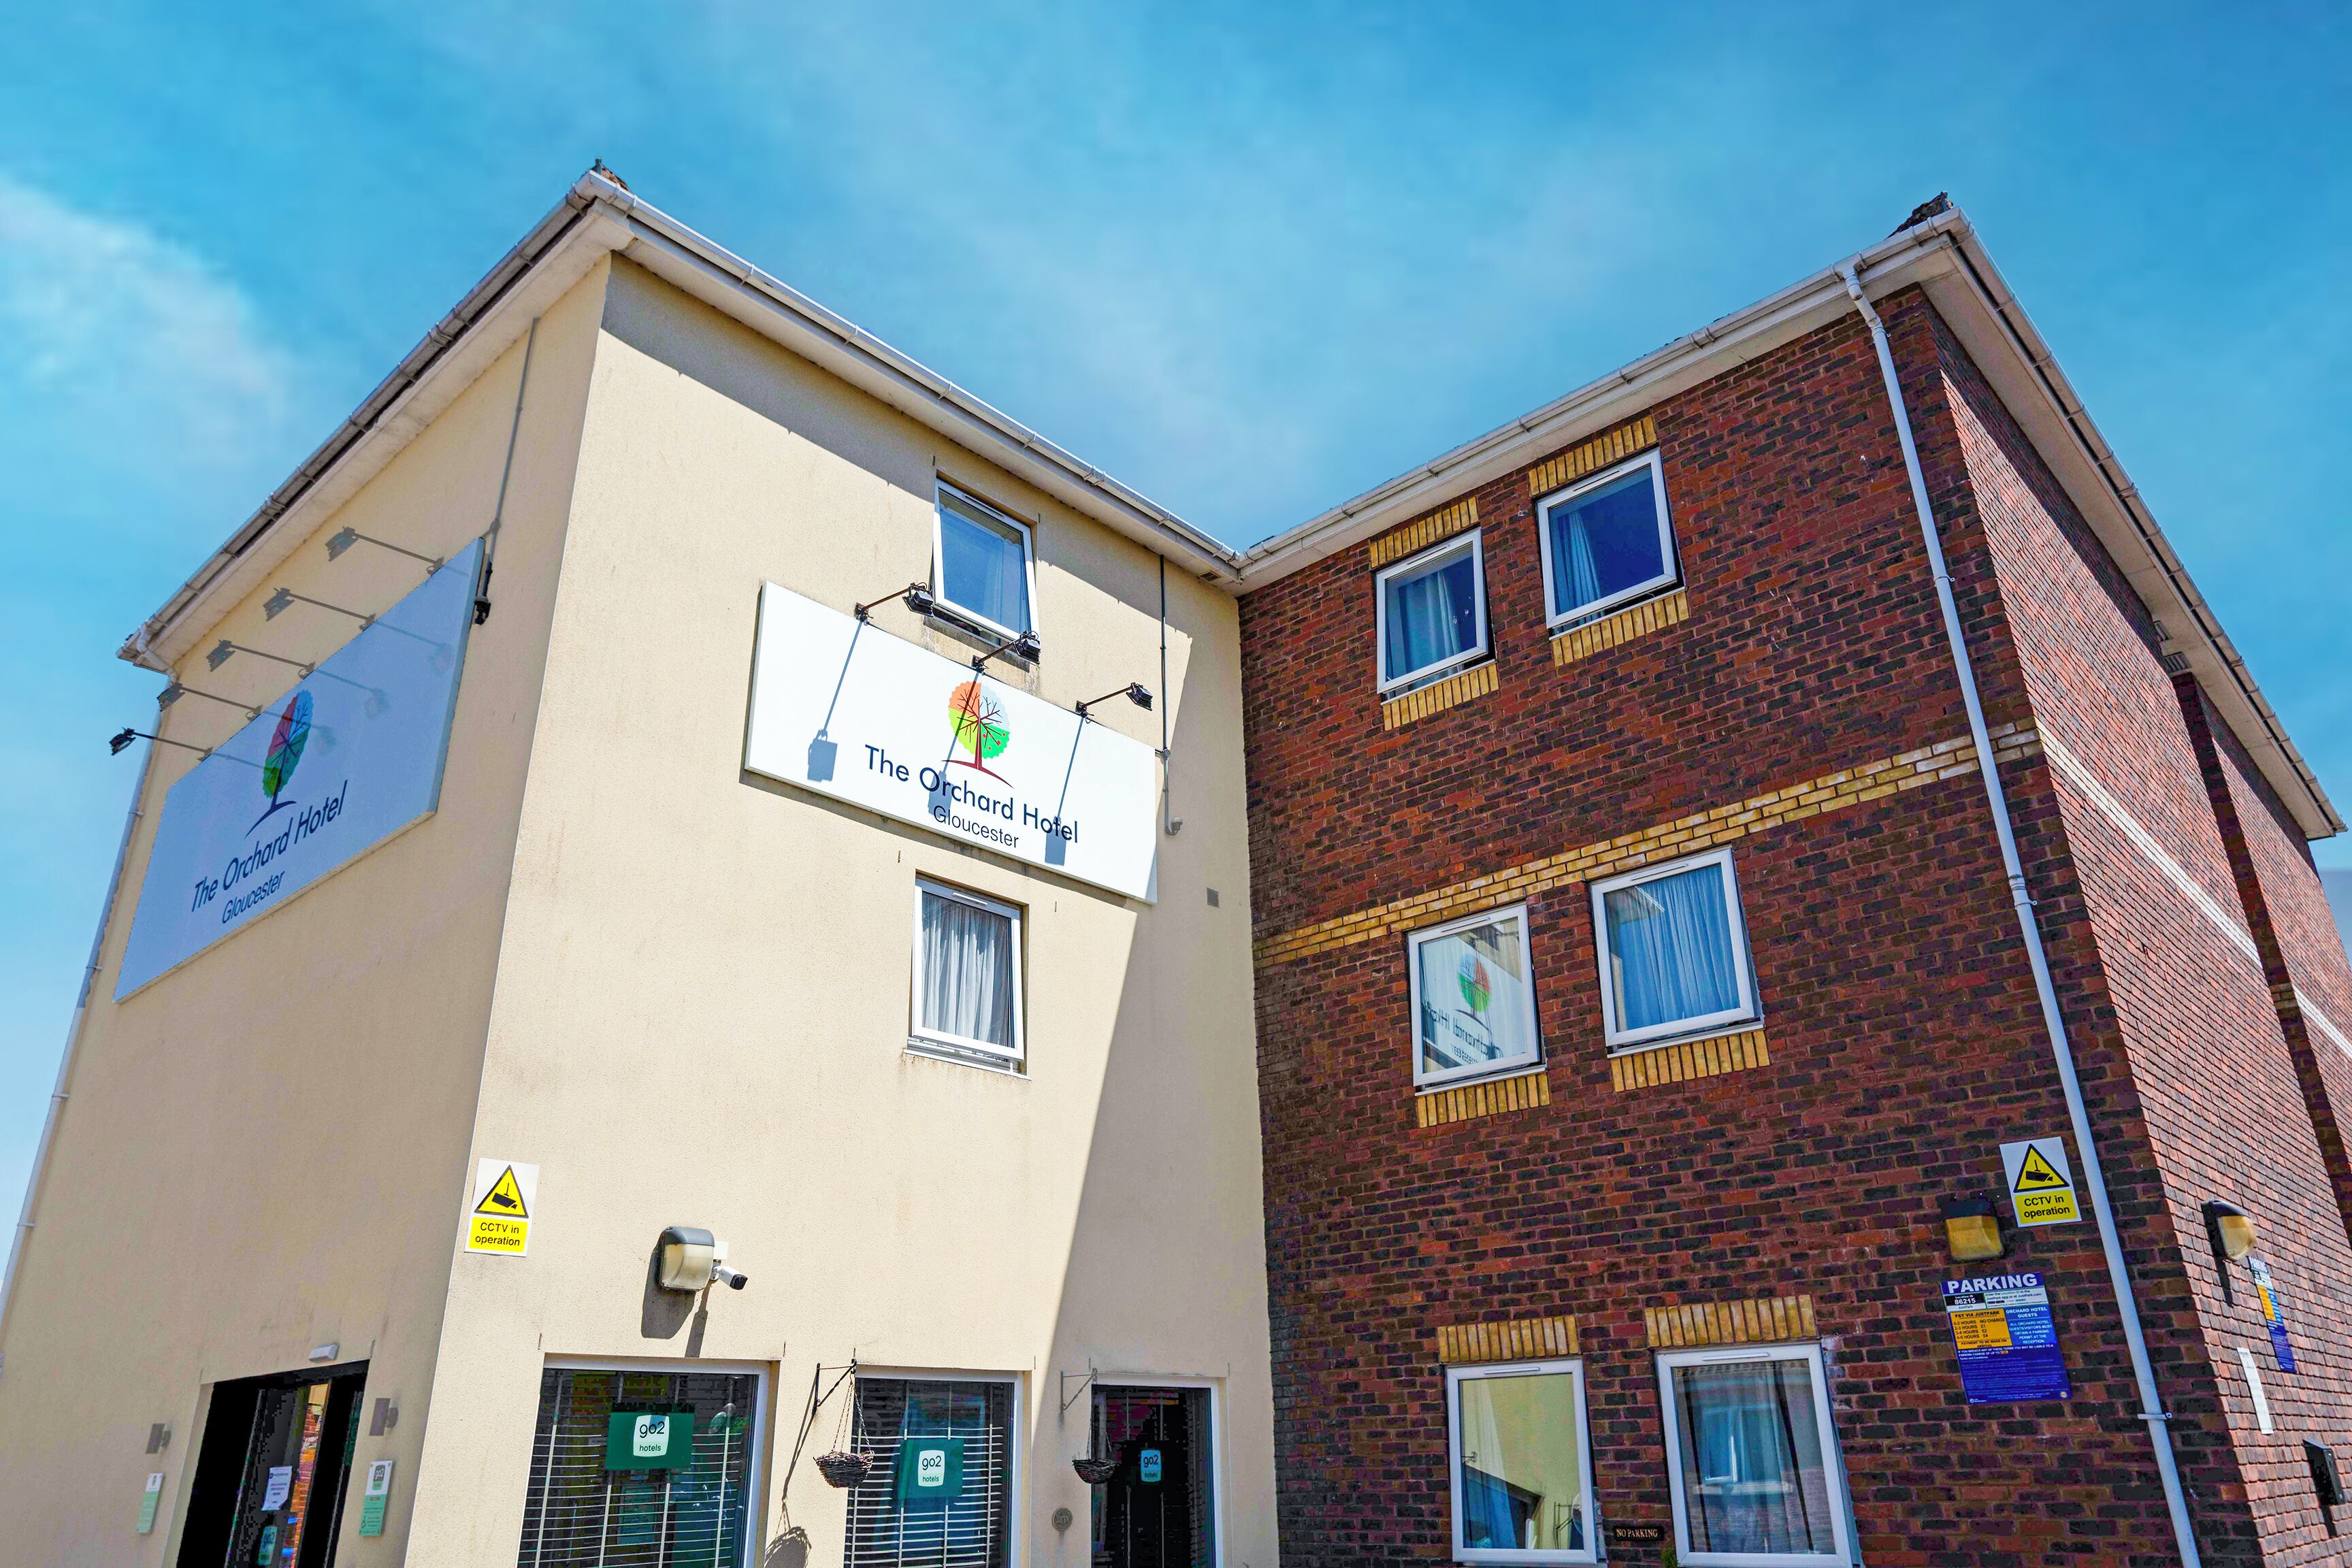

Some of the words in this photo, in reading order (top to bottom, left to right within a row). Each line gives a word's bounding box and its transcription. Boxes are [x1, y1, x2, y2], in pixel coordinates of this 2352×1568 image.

[865, 744, 909, 782] The
[919, 767, 1013, 821] Orchard
[1024, 803, 1077, 843] Hotel
[933, 805, 1019, 848] Gloucester
[191, 877, 218, 913] The
[223, 817, 293, 891] Orchard
[294, 779, 348, 845] Hotel
[222, 871, 285, 924] Gloucester
[2024, 1196, 2051, 1207] CCTV
[2024, 1207, 2070, 1219] operation
[480, 1222, 508, 1232] CCTV
[511, 1225, 519, 1234] in
[475, 1235, 520, 1246] operation
[1947, 1273, 2038, 1294] PARKING
[640, 1421, 665, 1439] go2
[922, 1455, 942, 1471] go2
[1143, 1454, 1159, 1468] go2
[1616, 1529, 1627, 1537] NO
[1627, 1529, 1658, 1538] PARKING
